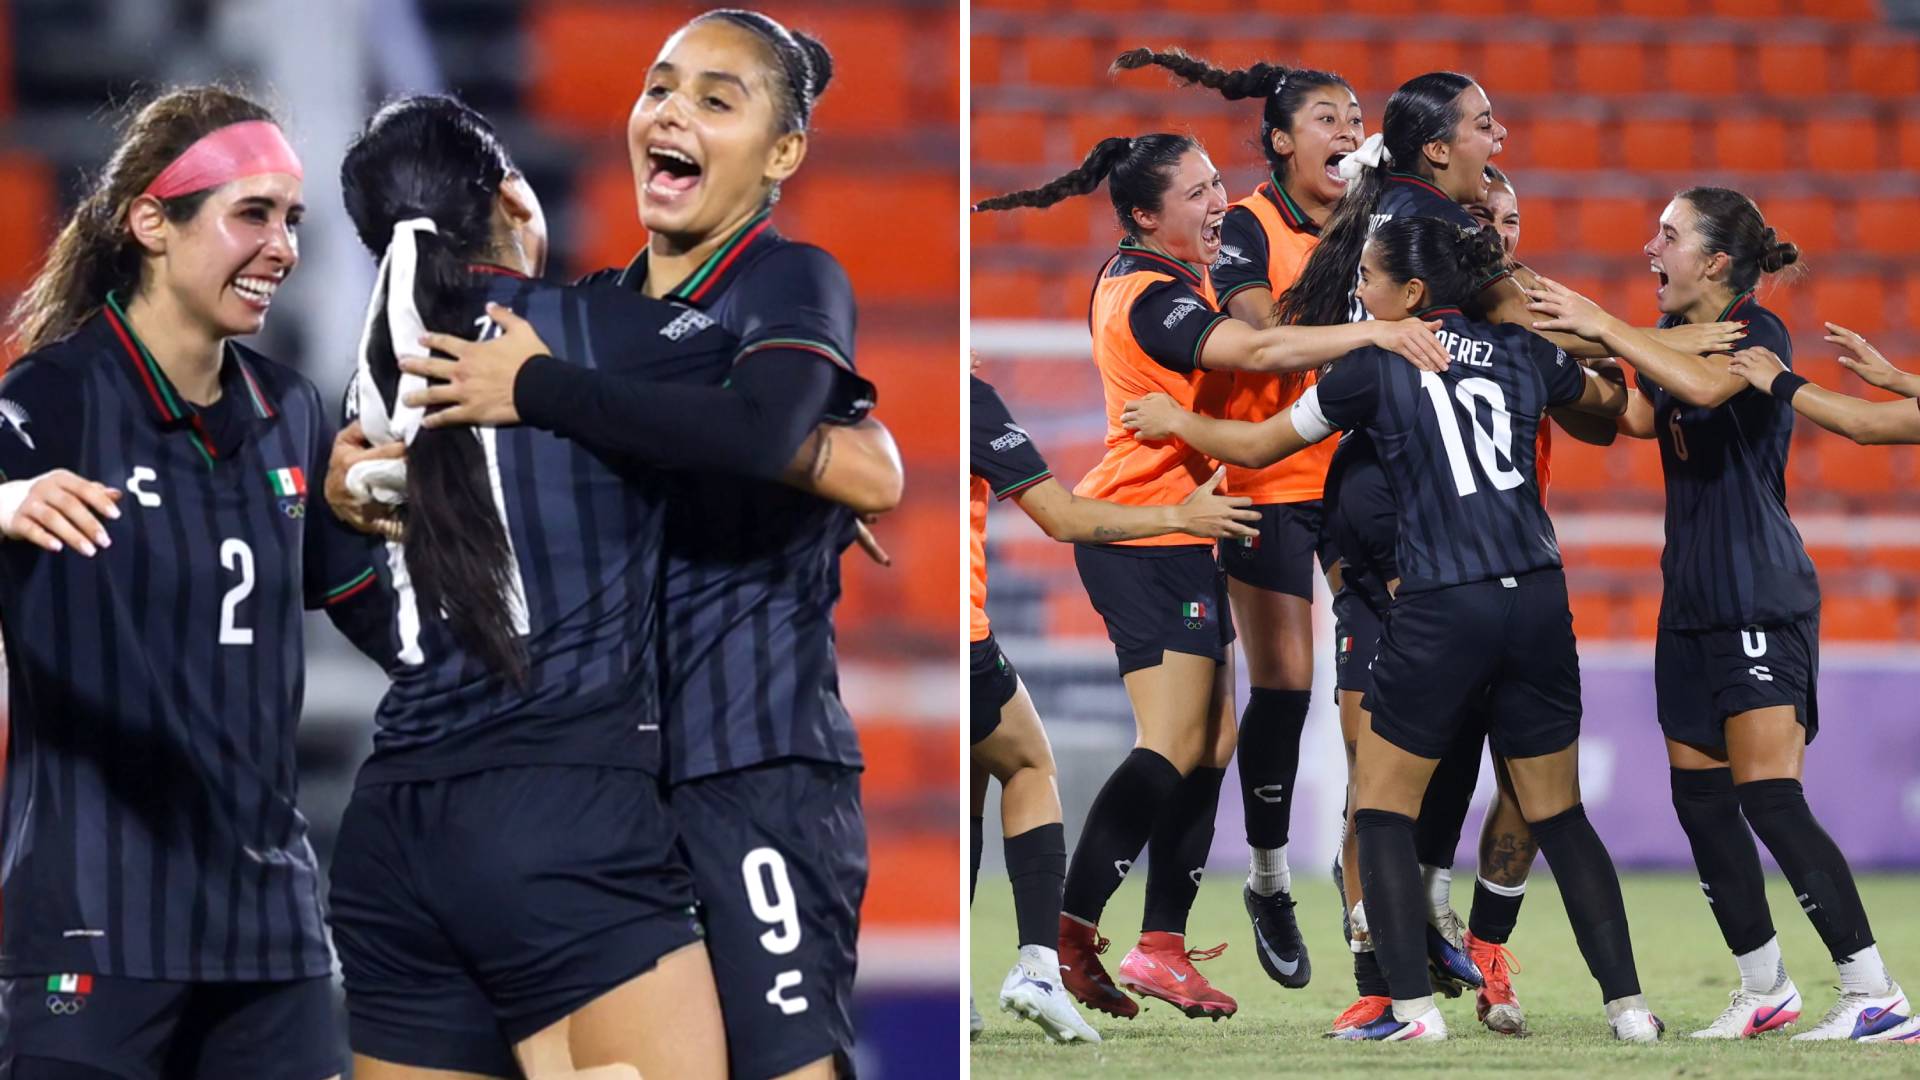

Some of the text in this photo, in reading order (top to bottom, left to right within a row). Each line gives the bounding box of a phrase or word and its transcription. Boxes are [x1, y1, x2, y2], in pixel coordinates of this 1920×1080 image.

[1420, 371, 1525, 497] 10
[219, 538, 255, 645] 2
[742, 847, 801, 954] 9
